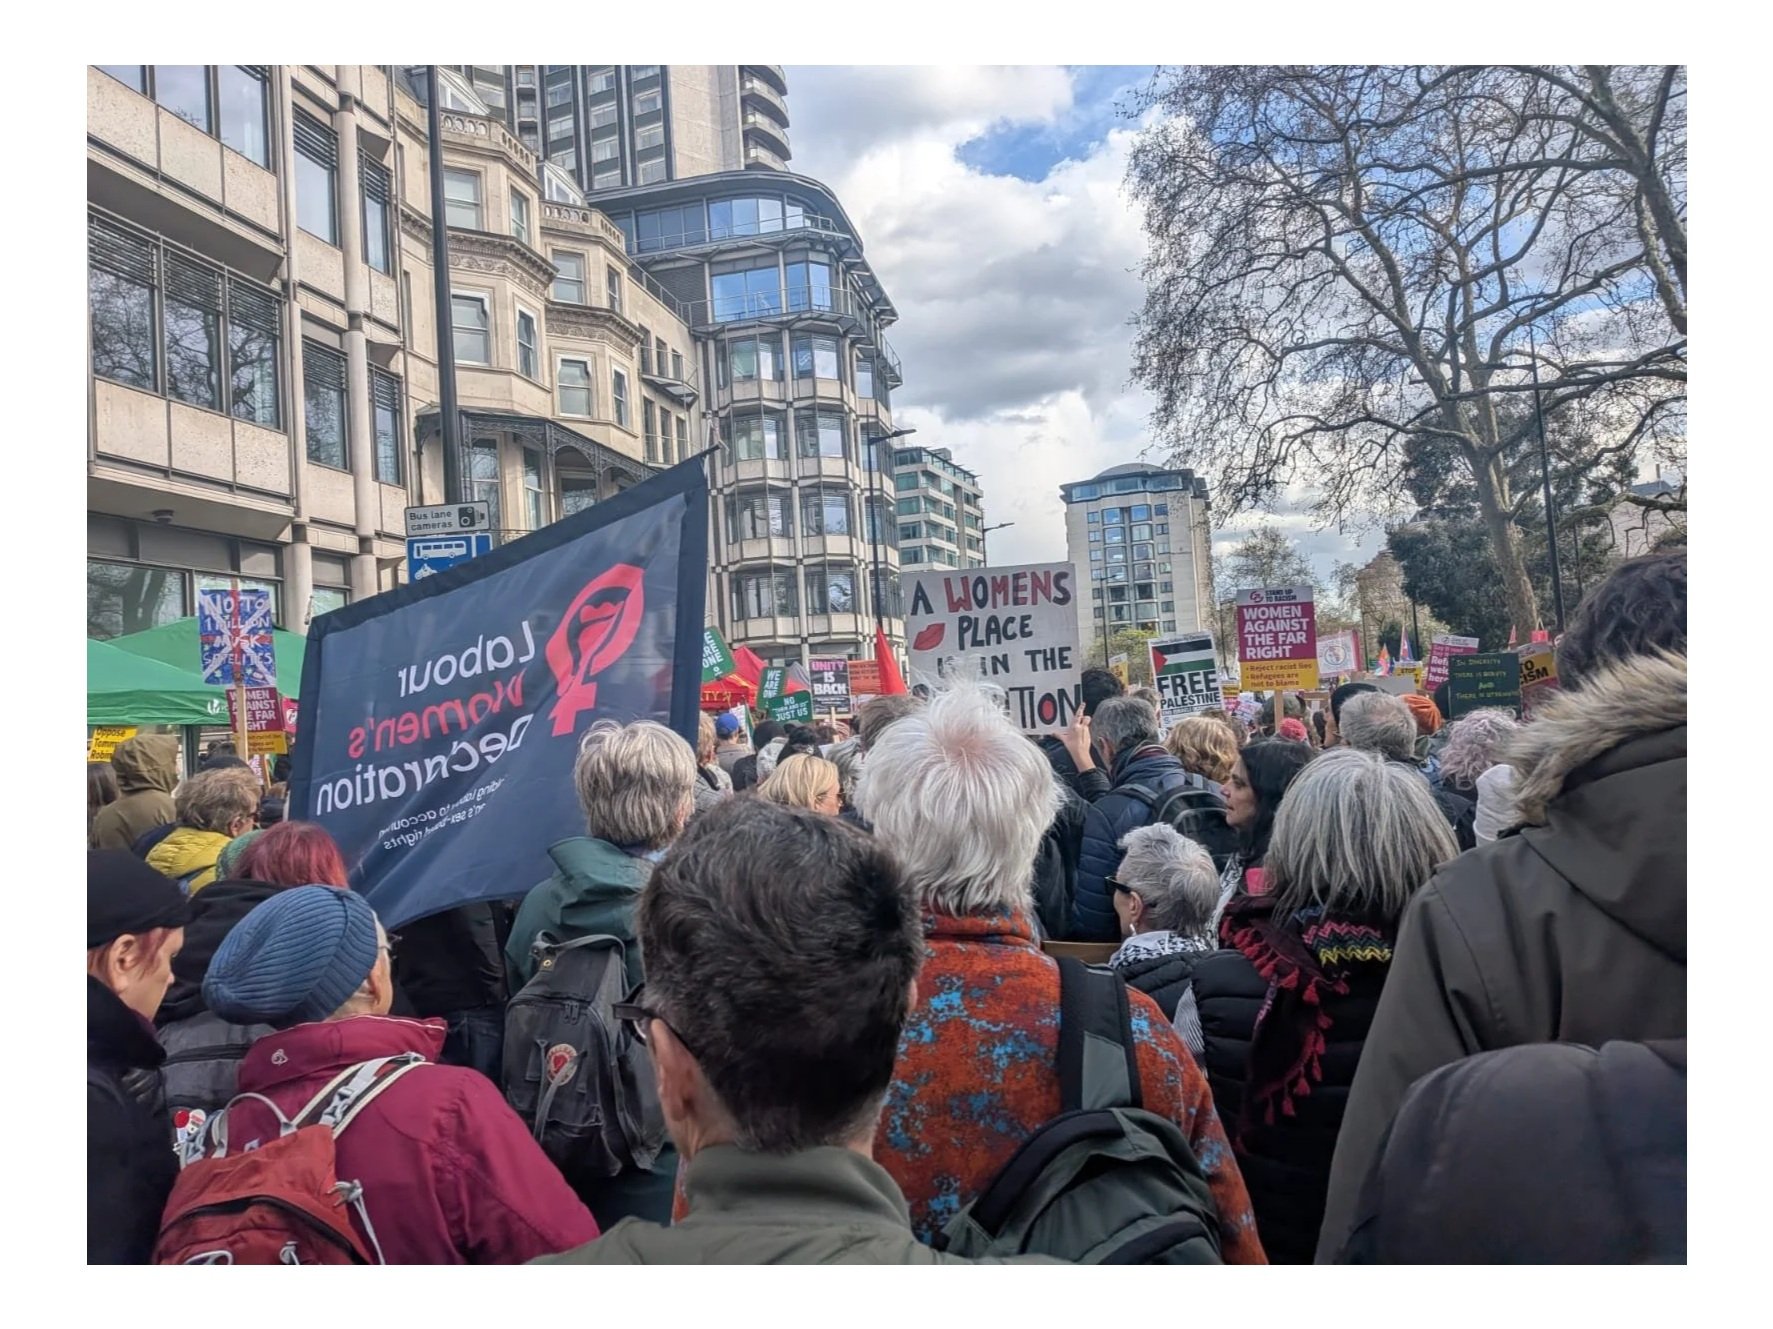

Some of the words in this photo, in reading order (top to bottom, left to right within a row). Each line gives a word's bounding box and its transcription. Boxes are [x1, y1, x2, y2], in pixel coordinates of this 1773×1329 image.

[409, 512, 428, 520] Bus
[431, 511, 452, 519] lane
[411, 521, 453, 531] cameras
[911, 580, 934, 616] A
[944, 570, 1072, 613] WOMENS
[203, 594, 235, 615] NO
[1243, 605, 1302, 620] WOMEN
[1244, 618, 1310, 633] AGAINST
[958, 614, 1034, 650] PLACE
[1244, 633, 1275, 646] THE
[1278, 631, 1307, 644] FAR
[1246, 646, 1293, 659] RIGHT
[702, 652, 724, 668] ONE
[1024, 647, 1073, 672] THE
[811, 661, 845, 671] UNITY
[1250, 664, 1274, 672] Reject
[767, 670, 782, 681] WE
[824, 671, 835, 683] IS
[764, 680, 779, 690] ARE
[813, 683, 847, 695] BACK
[1156, 670, 1219, 698] FREE
[230, 690, 270, 700] WMEN
[783, 696, 795, 706] NO
[1161, 692, 1221, 709] PALESTINE
[232, 700, 275, 712] AAINST
[255, 710, 276, 720] FAR
[775, 710, 796, 722] JUST
[797, 707, 808, 717] US
[96, 726, 126, 738] Oppose
